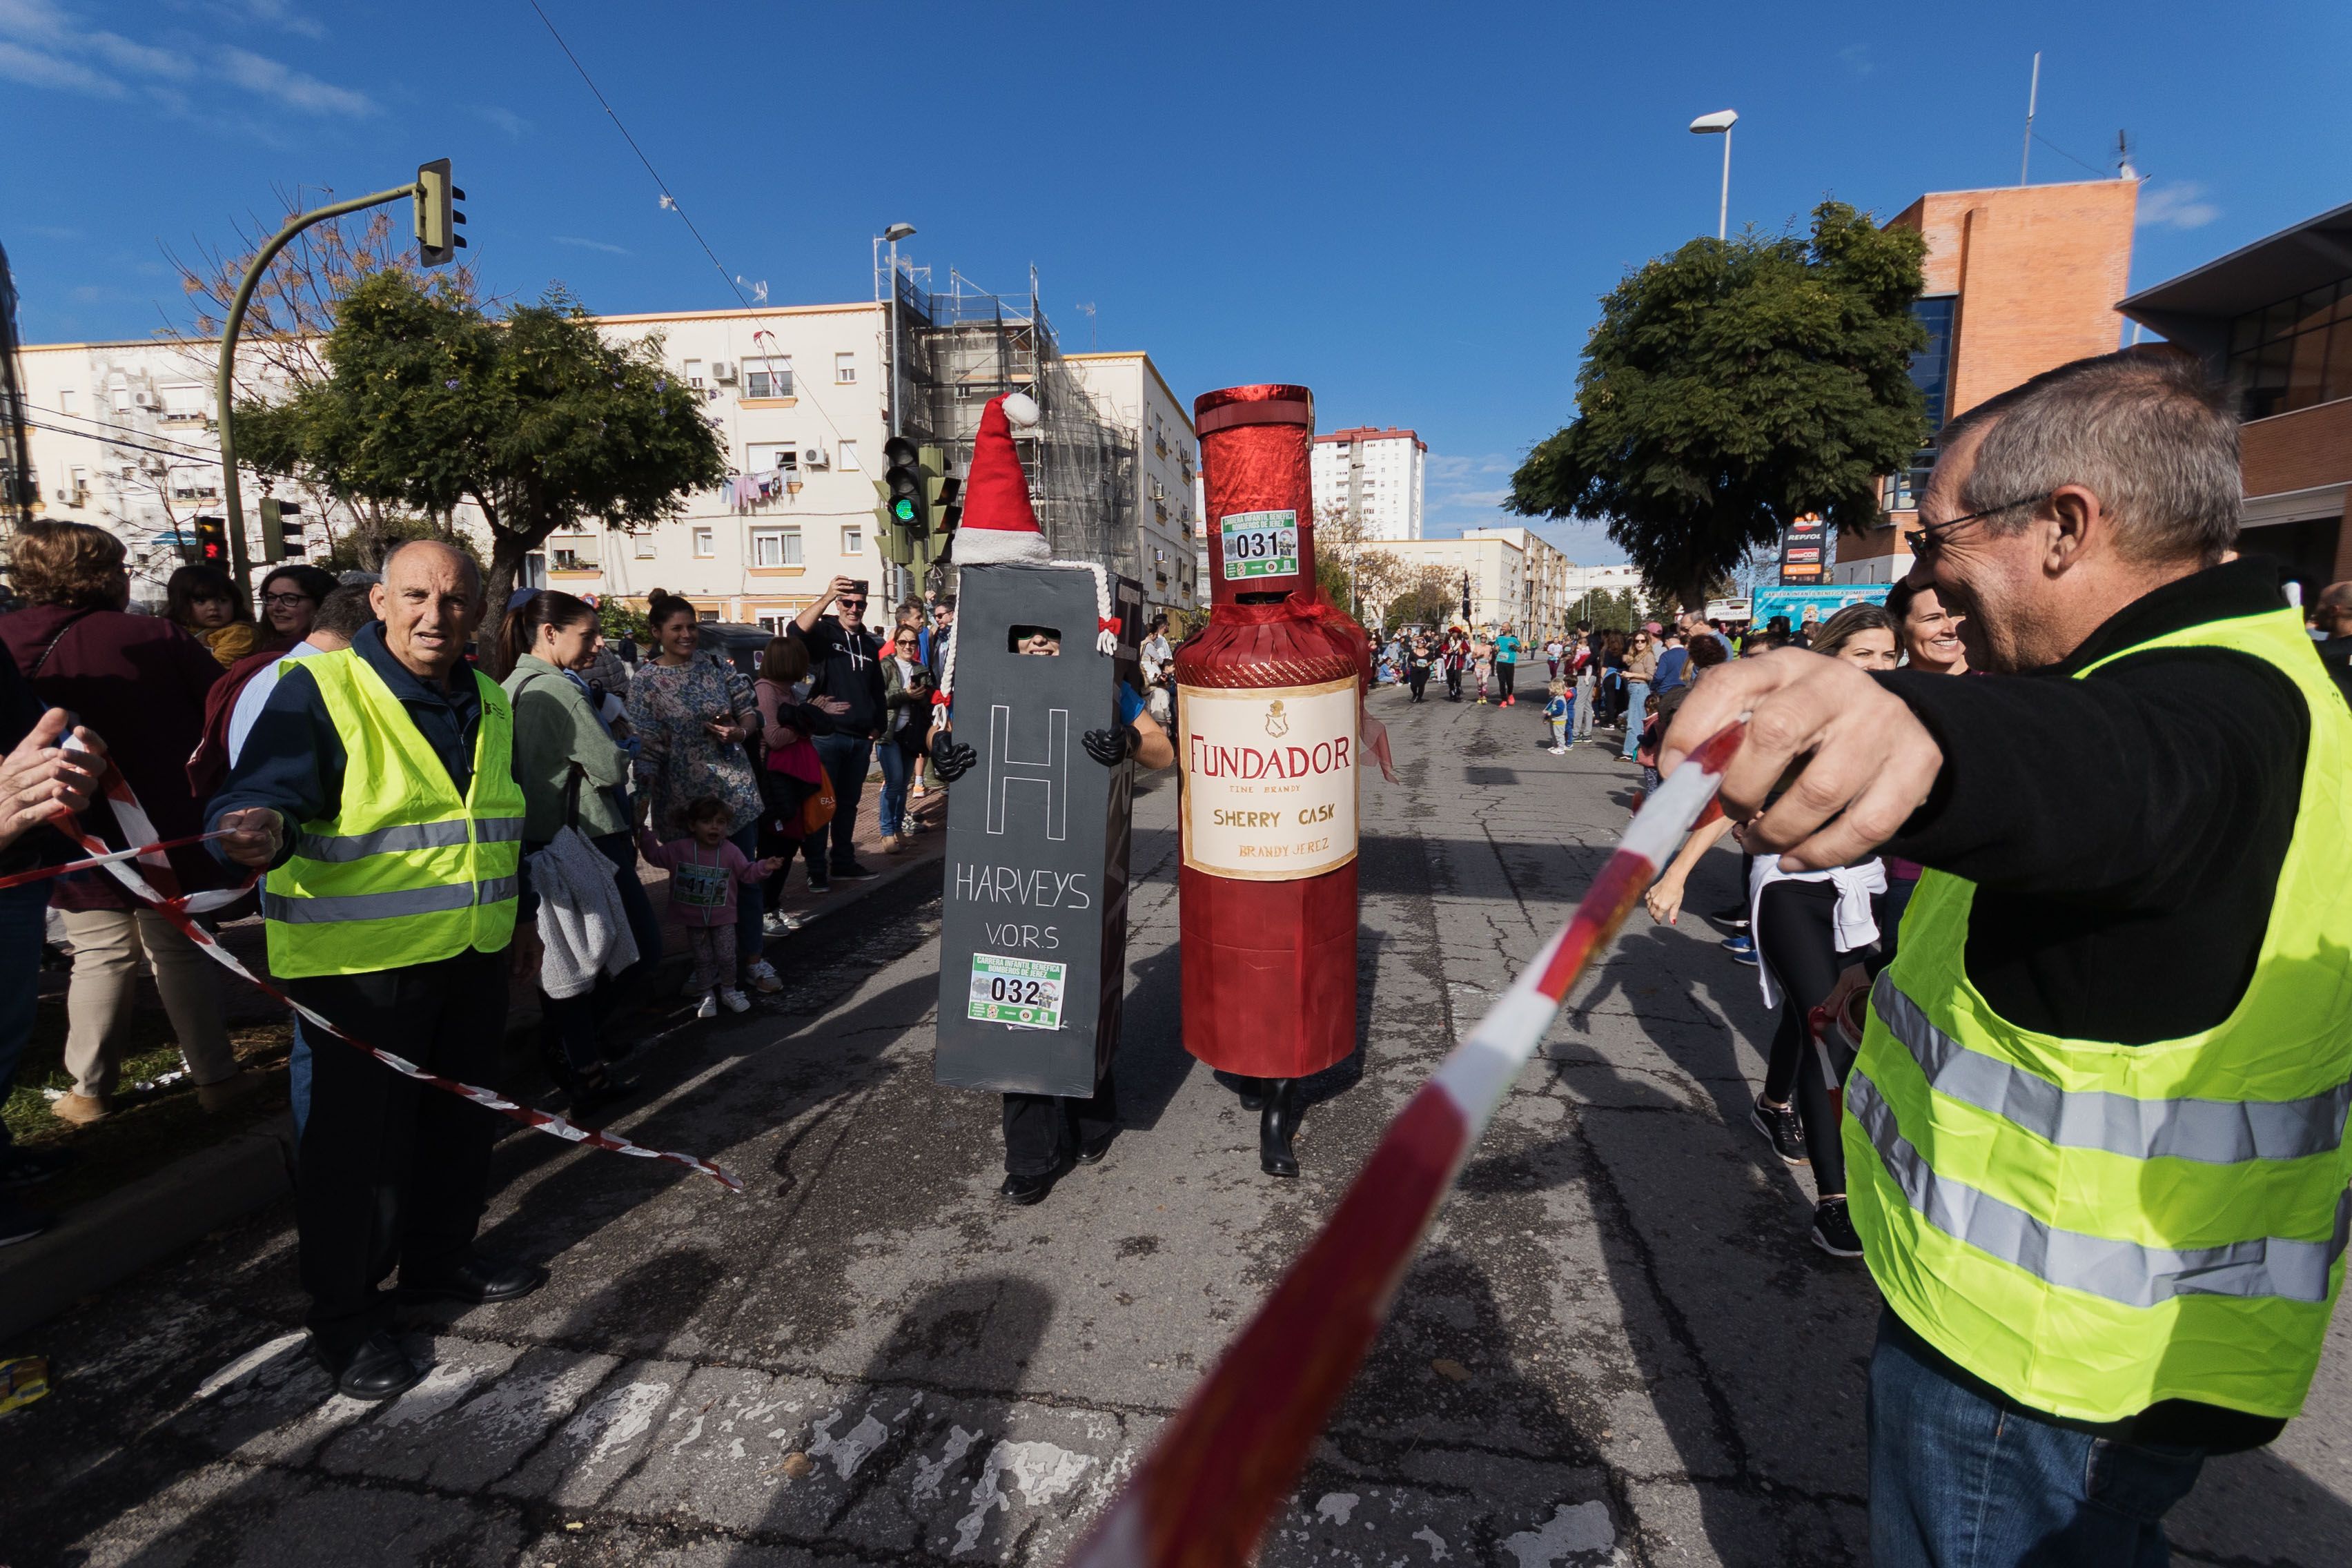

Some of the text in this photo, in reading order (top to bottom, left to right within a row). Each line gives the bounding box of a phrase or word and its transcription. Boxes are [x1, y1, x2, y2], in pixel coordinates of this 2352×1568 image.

[1232, 521, 1260, 531] BOMBEROS
[1244, 513, 1268, 523] INFANTIL
[1237, 531, 1278, 558] 031
[1190, 733, 1351, 779] FUNDADOR
[986, 704, 1069, 841] H
[1264, 785, 1300, 794] BRANDY
[1213, 803, 1335, 828] SHERRY CASK
[1238, 837, 1329, 857] BRANDY JEREZ
[956, 863, 1090, 909] HARVEYS
[986, 922, 1059, 949] V.O.R.S
[977, 956, 1060, 973] CARRERA INFANTIL BENEFICA
[988, 965, 1020, 975] BOMBEROS
[1030, 970, 1048, 979] JEREZ
[991, 977, 1040, 1006] 032
